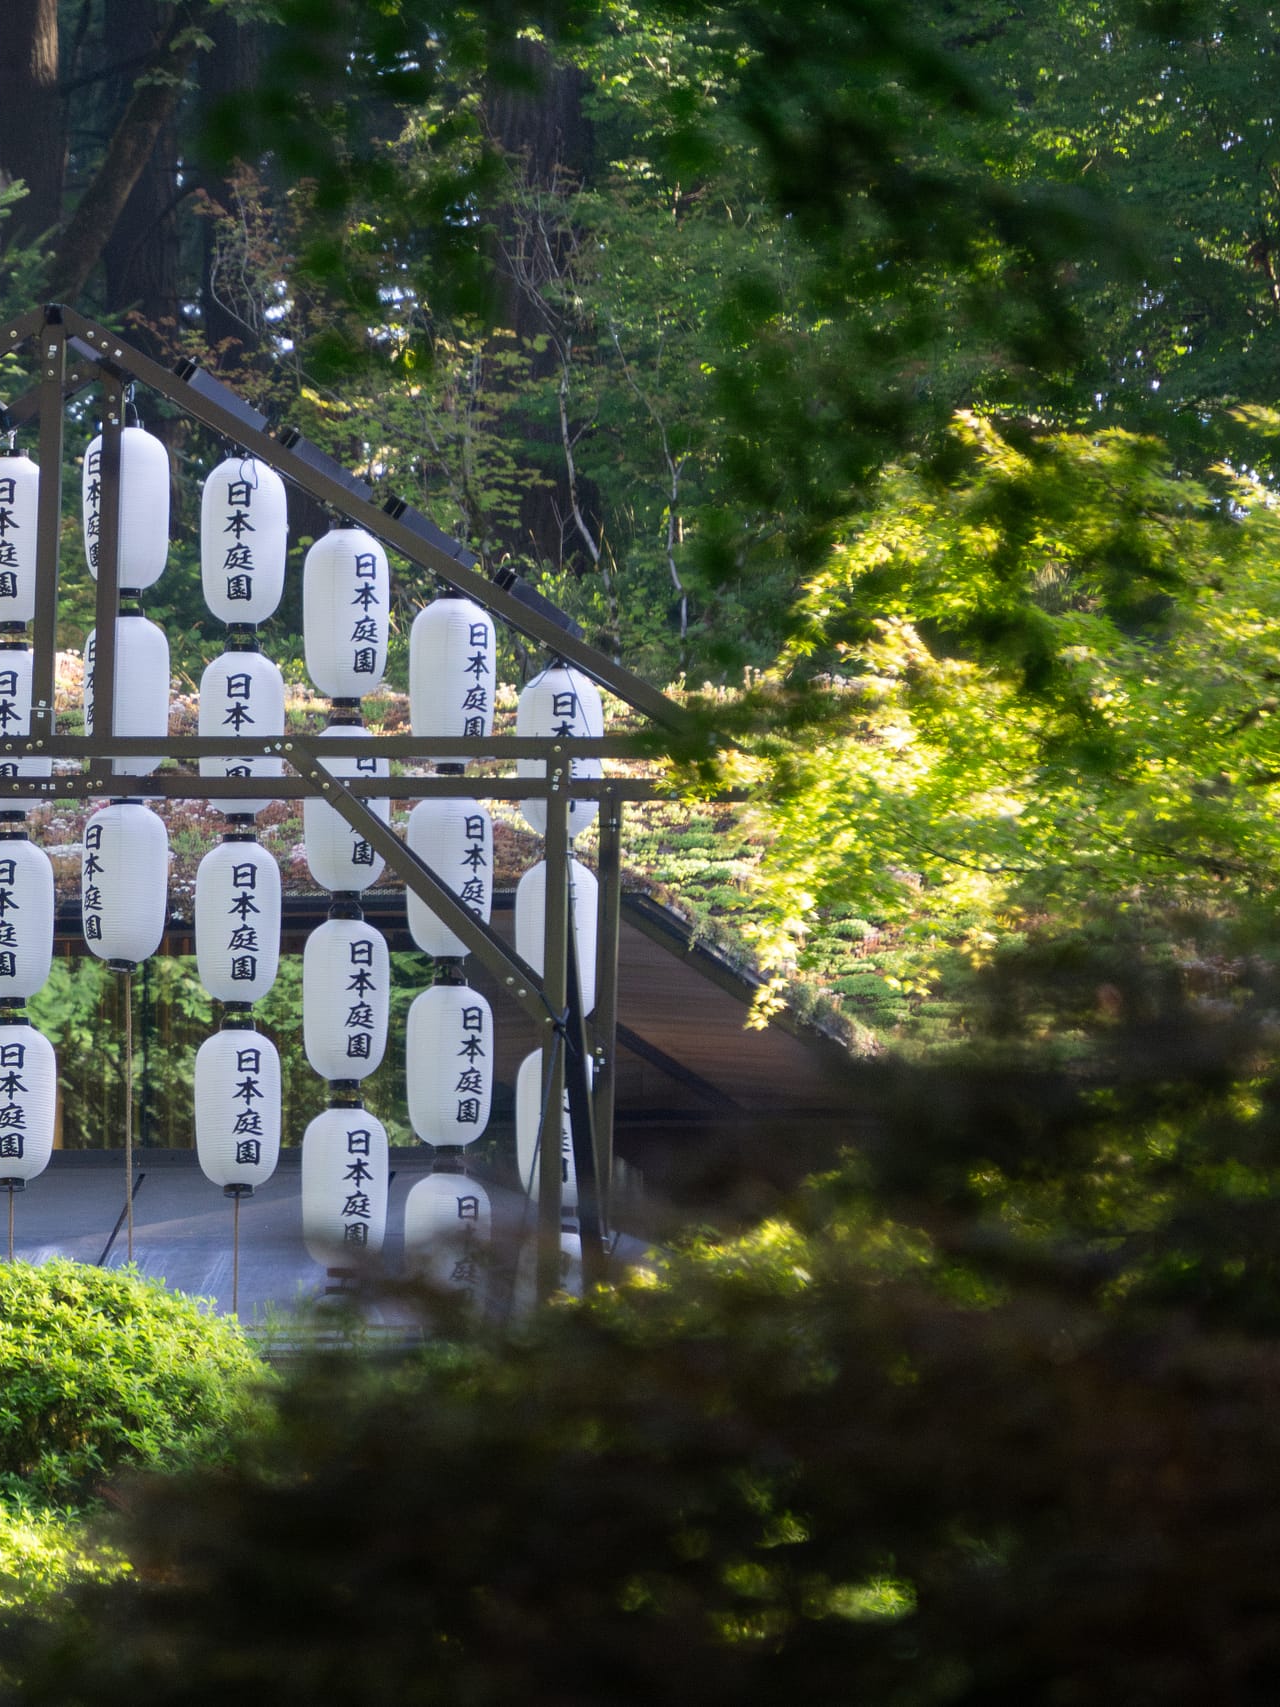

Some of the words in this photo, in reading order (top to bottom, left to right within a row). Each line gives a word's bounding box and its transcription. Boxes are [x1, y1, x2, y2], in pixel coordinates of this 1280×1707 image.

[223, 481, 257, 602] 日本庭園
[350, 553, 380, 674] 日本庭園
[462, 622, 490, 737] 日本庭園
[83, 824, 104, 941] 日本庭園
[227, 862, 261, 982] 日本庭園
[460, 814, 488, 916] 日本庭
[345, 940, 377, 1060] 日本庭園
[232, 1048, 265, 1166] 日本庭園
[455, 1006, 486, 1124] 日本庭園
[341, 1129, 374, 1249] 日本庭園
